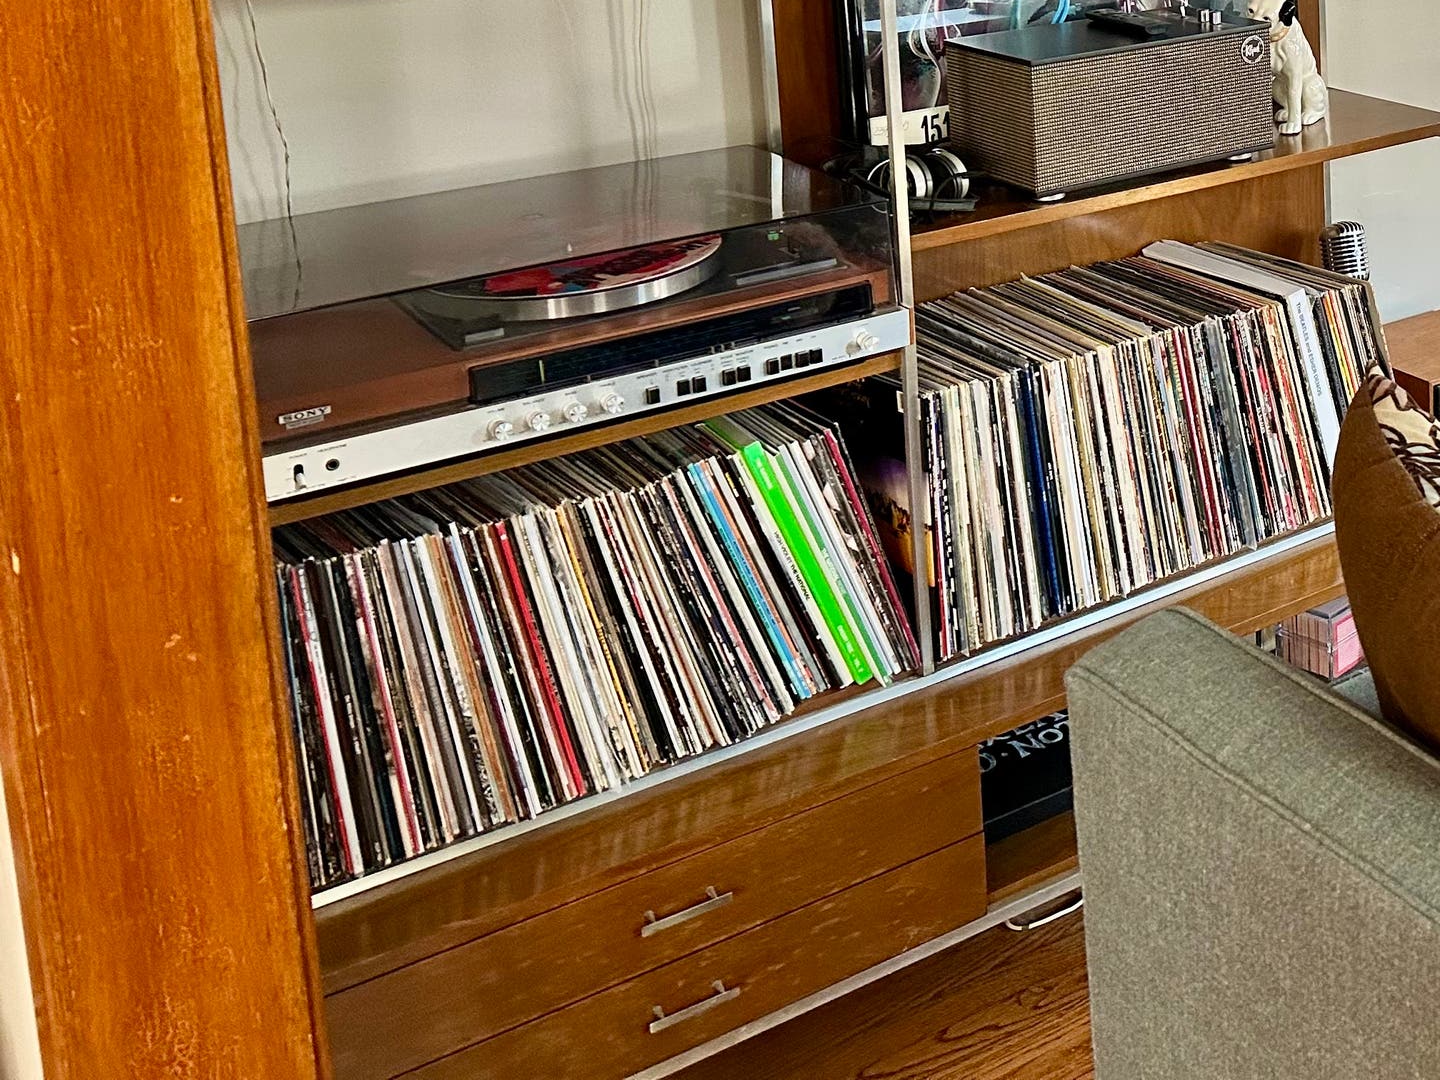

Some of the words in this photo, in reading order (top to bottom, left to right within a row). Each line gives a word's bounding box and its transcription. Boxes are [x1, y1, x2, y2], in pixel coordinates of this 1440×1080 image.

[921, 111, 950, 142] 151
[1299, 313, 1310, 342] BEATLES
[282, 406, 329, 421] SONY
